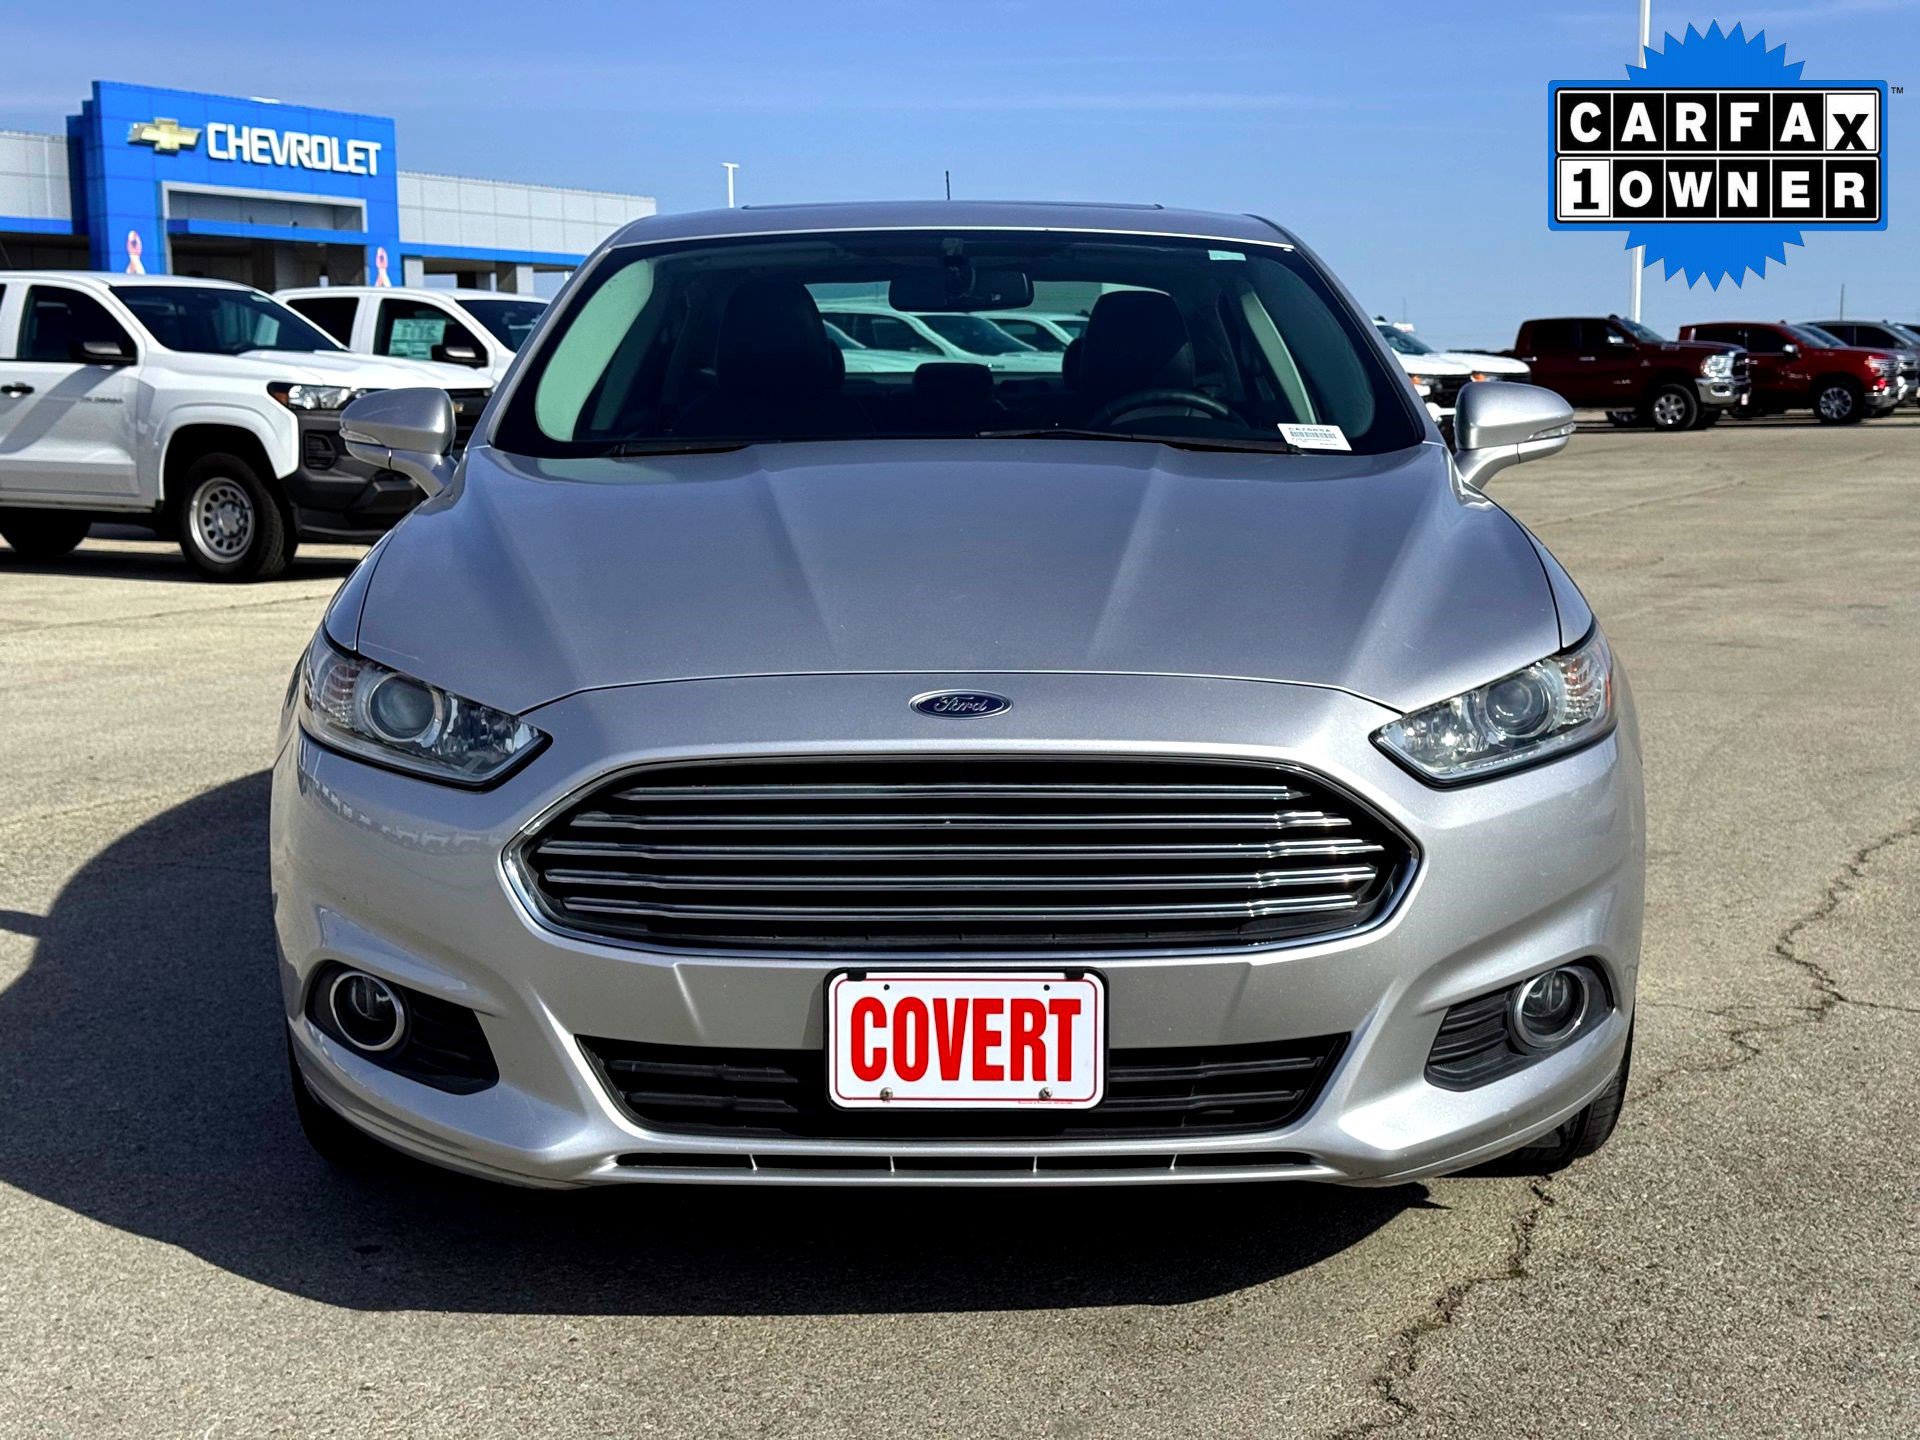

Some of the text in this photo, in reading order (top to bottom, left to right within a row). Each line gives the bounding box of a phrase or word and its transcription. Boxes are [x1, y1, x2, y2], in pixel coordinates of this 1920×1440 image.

[207, 122, 382, 176] CHEVROLET
[933, 696, 988, 712] Ford
[850, 996, 1081, 1082] COVERT
